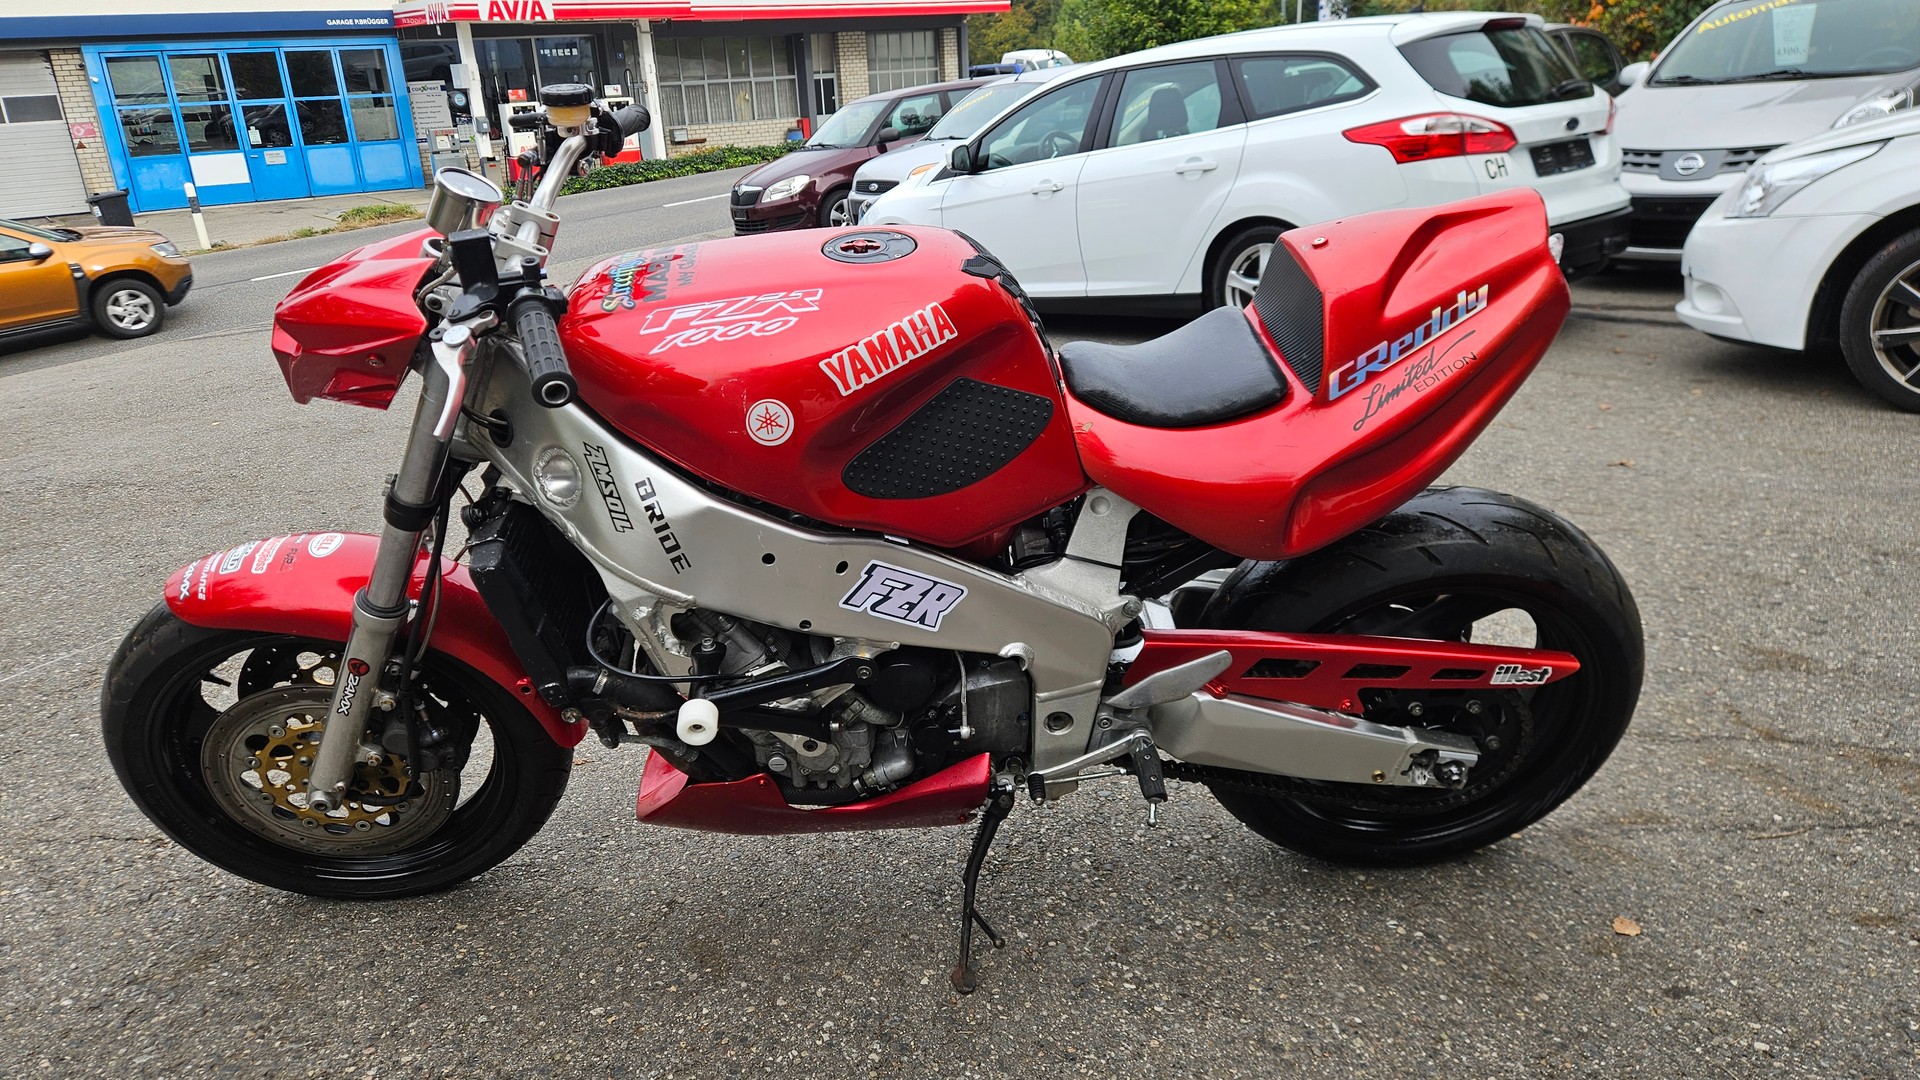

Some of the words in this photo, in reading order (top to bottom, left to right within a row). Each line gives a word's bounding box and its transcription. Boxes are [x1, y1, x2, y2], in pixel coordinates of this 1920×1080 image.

[428, 2, 446, 25] AVIA
[488, 0, 547, 20] AVIA
[1697, 0, 1798, 34] Automa
[1485, 157, 1509, 179] CH
[643, 255, 672, 302] MADE
[648, 316, 798, 354] 1000
[822, 303, 957, 394] YAMAHA
[1352, 329, 1476, 432] Limited
[1413, 351, 1478, 393] EDITION
[583, 441, 634, 533] AMSOIL
[842, 562, 966, 629] FZR
[338, 672, 360, 716] 24MX
[1491, 665, 1552, 684] illest
